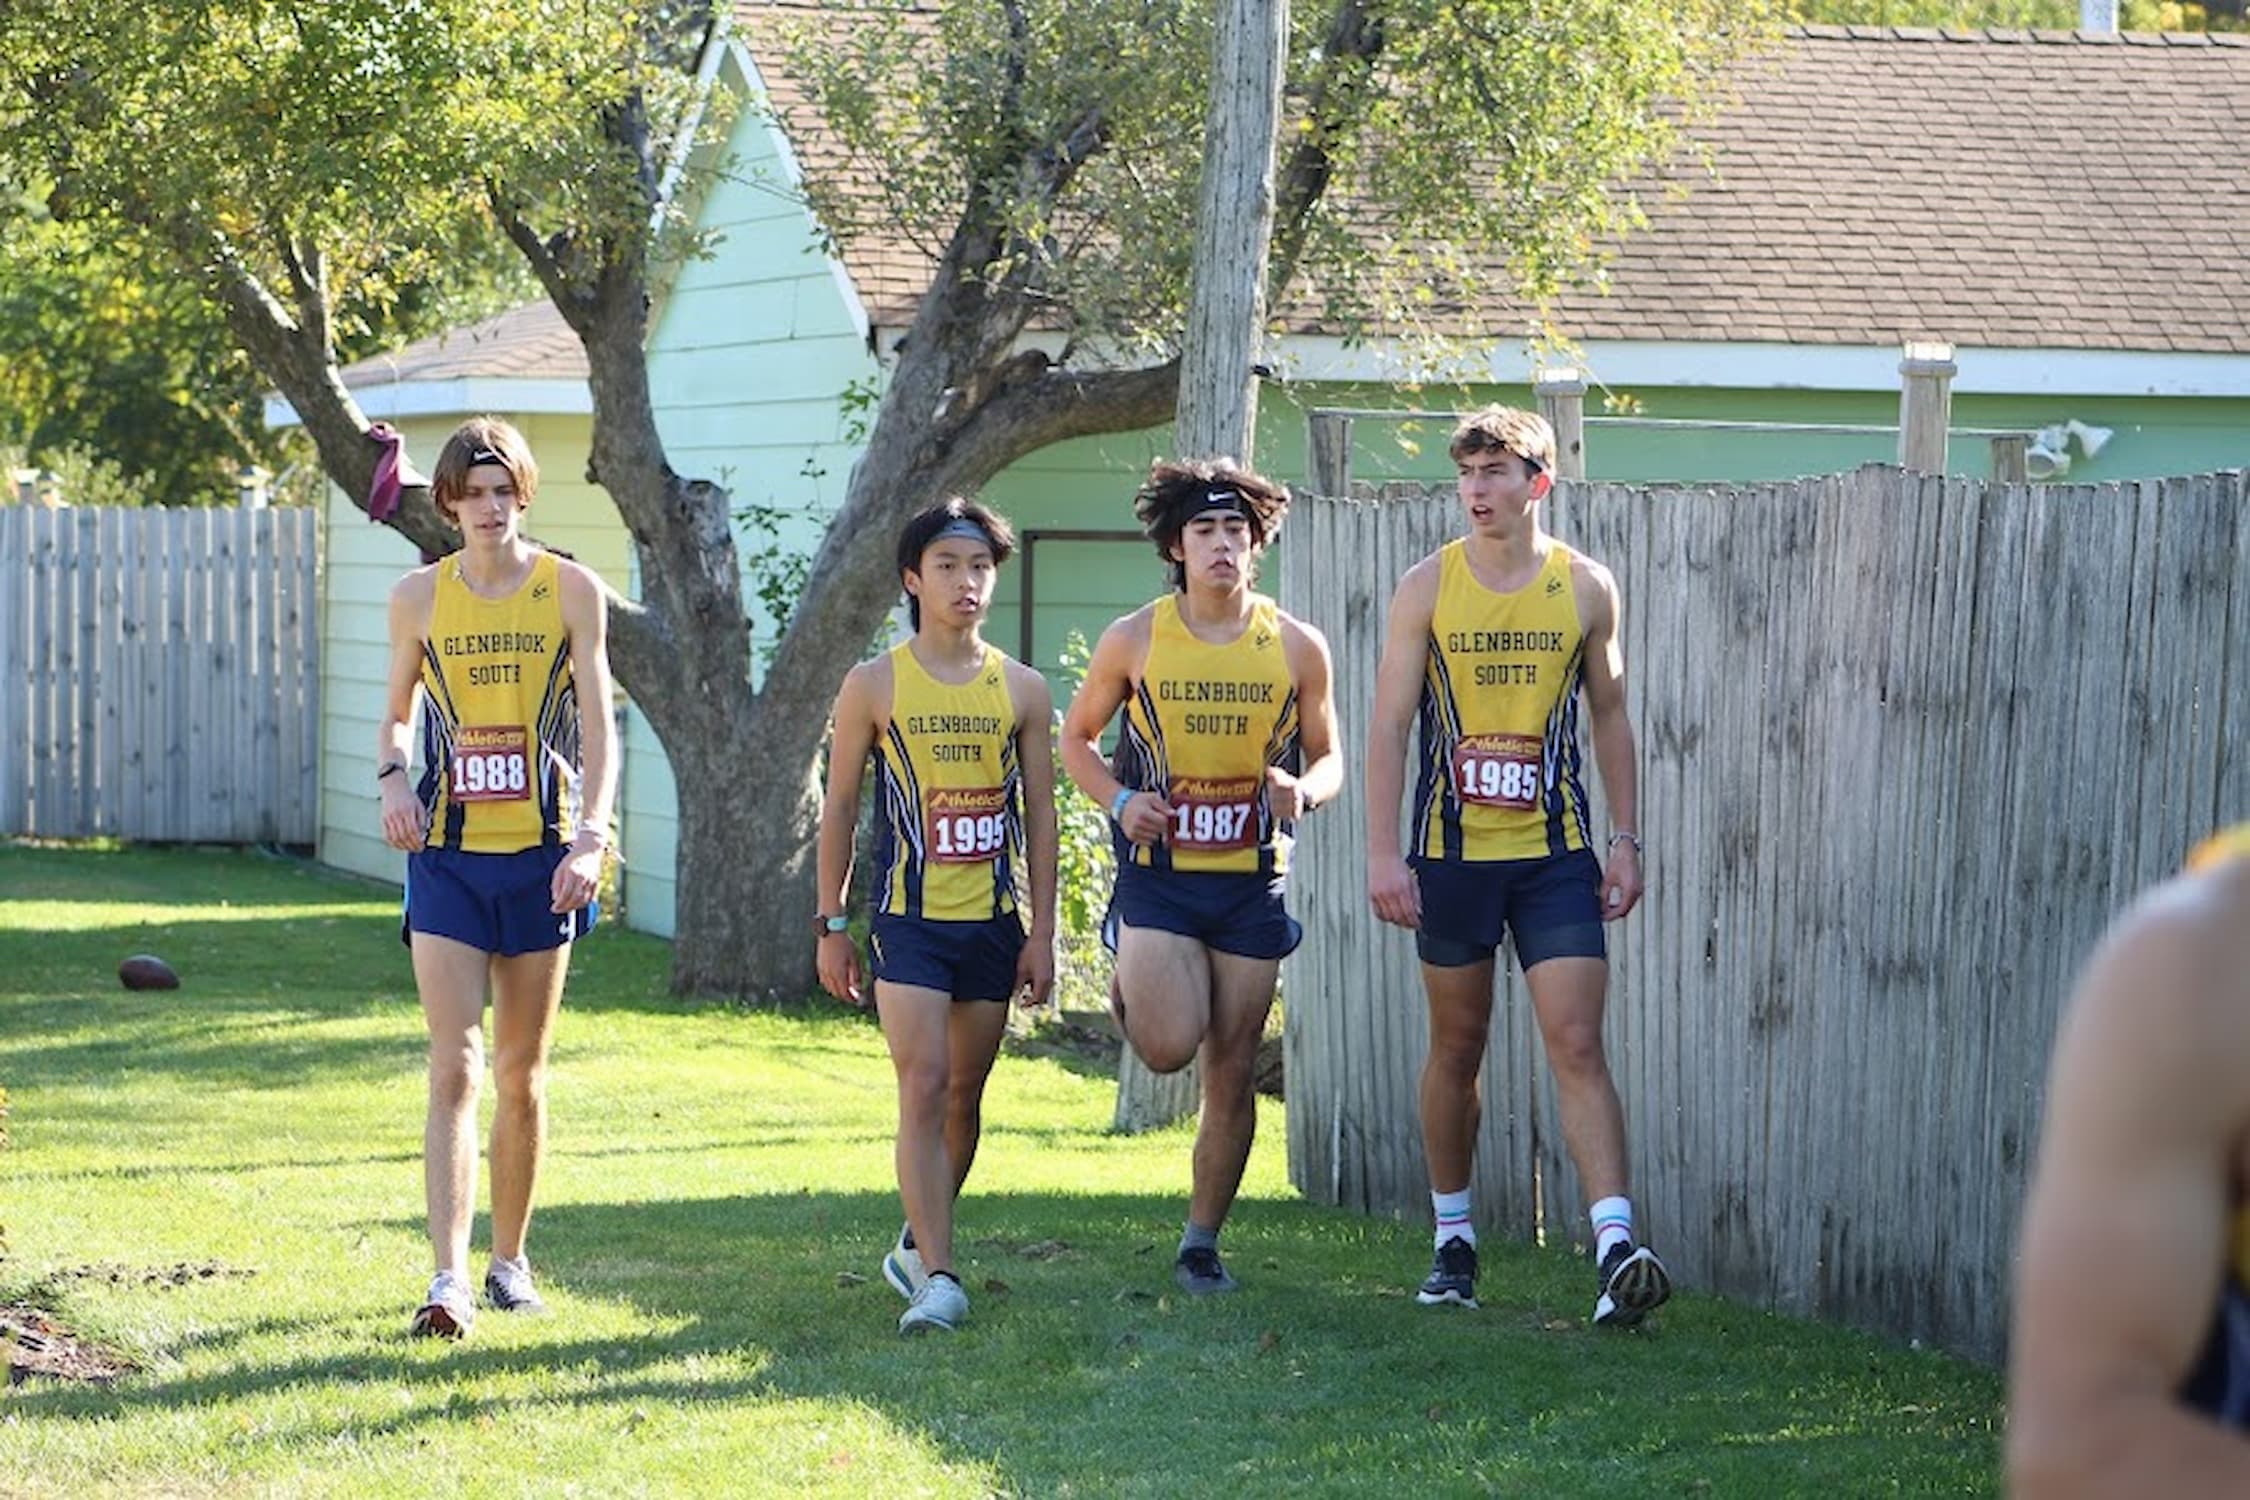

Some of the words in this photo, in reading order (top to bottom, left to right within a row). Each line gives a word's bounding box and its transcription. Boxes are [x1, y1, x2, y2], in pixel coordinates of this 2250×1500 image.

[1448, 632, 1564, 653] GLENBROOK
[1474, 664, 1537, 685] SOUTH
[1159, 680, 1273, 703] GLENBROOK
[908, 715, 1001, 735] GLENBROOK
[1184, 713, 1249, 735] SOUTH
[932, 744, 982, 762] SOUTH
[453, 754, 526, 792] 1988
[1461, 758, 1538, 801] 1985
[936, 812, 1005, 854] 1995
[1174, 803, 1252, 842] 1987
